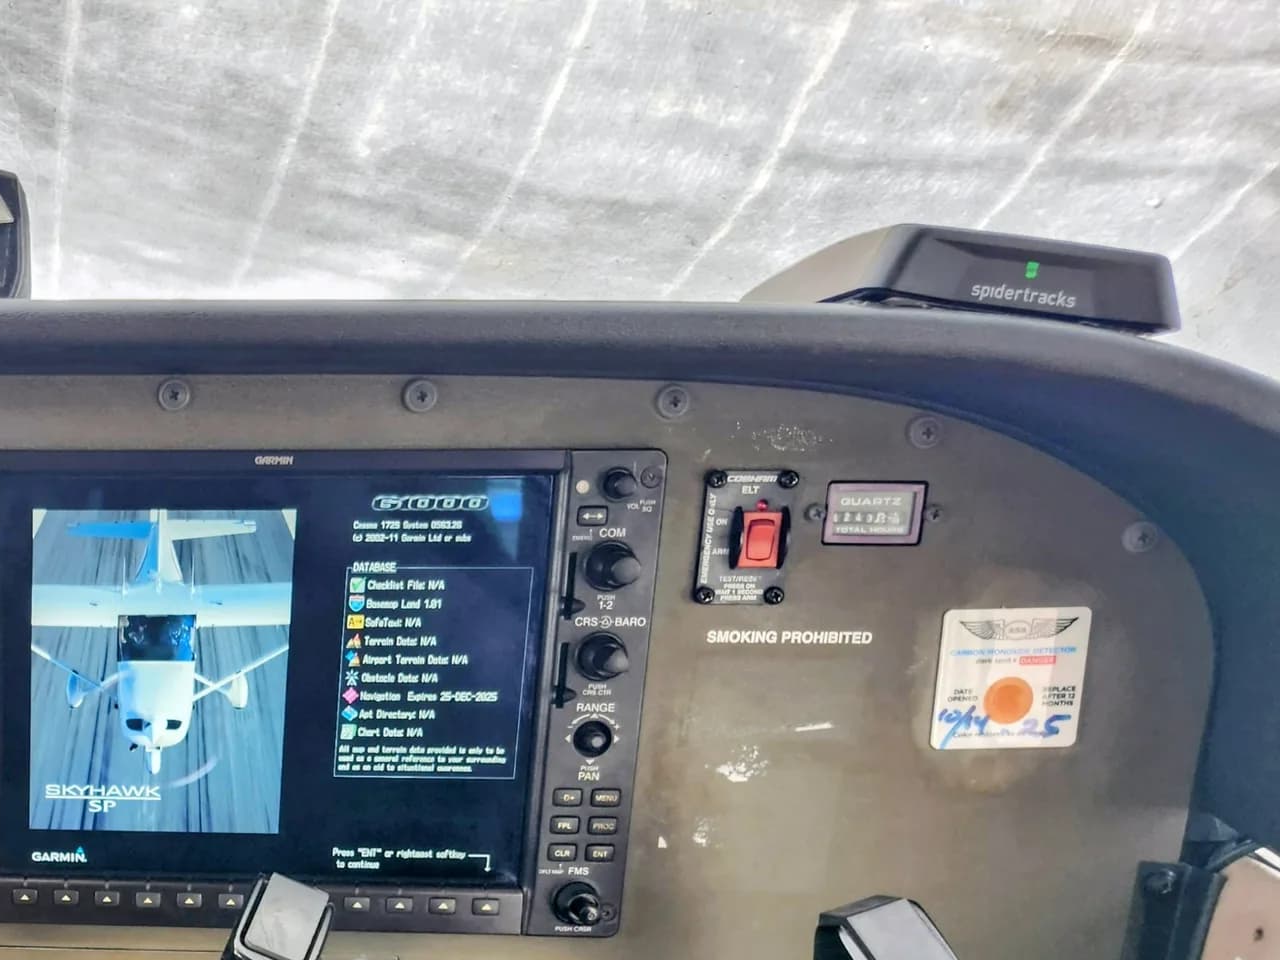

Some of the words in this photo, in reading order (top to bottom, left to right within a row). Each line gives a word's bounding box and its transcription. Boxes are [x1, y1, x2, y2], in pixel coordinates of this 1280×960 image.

[971, 284, 1076, 308] spidertracks
[255, 456, 294, 465] GARMIN
[742, 485, 760, 494] ELT
[840, 496, 902, 506] QUARTZ
[715, 518, 728, 526] ON
[599, 528, 627, 538] COM
[352, 563, 397, 573] DATABASE
[599, 601, 613, 610] 1-2
[575, 617, 598, 627] CRS
[614, 617, 646, 627] BARO
[707, 630, 778, 644] SMOKING
[781, 630, 873, 645] PROHIBITED
[576, 703, 616, 713] RANGE
[578, 771, 600, 781] PAN
[45, 784, 161, 797] SKYHAWK
[595, 794, 618, 802] MENU
[88, 800, 117, 813] SP
[592, 822, 615, 830] PROC
[554, 850, 571, 858] CLR
[592, 850, 608, 858] ENT
[568, 867, 589, 876] FMS
